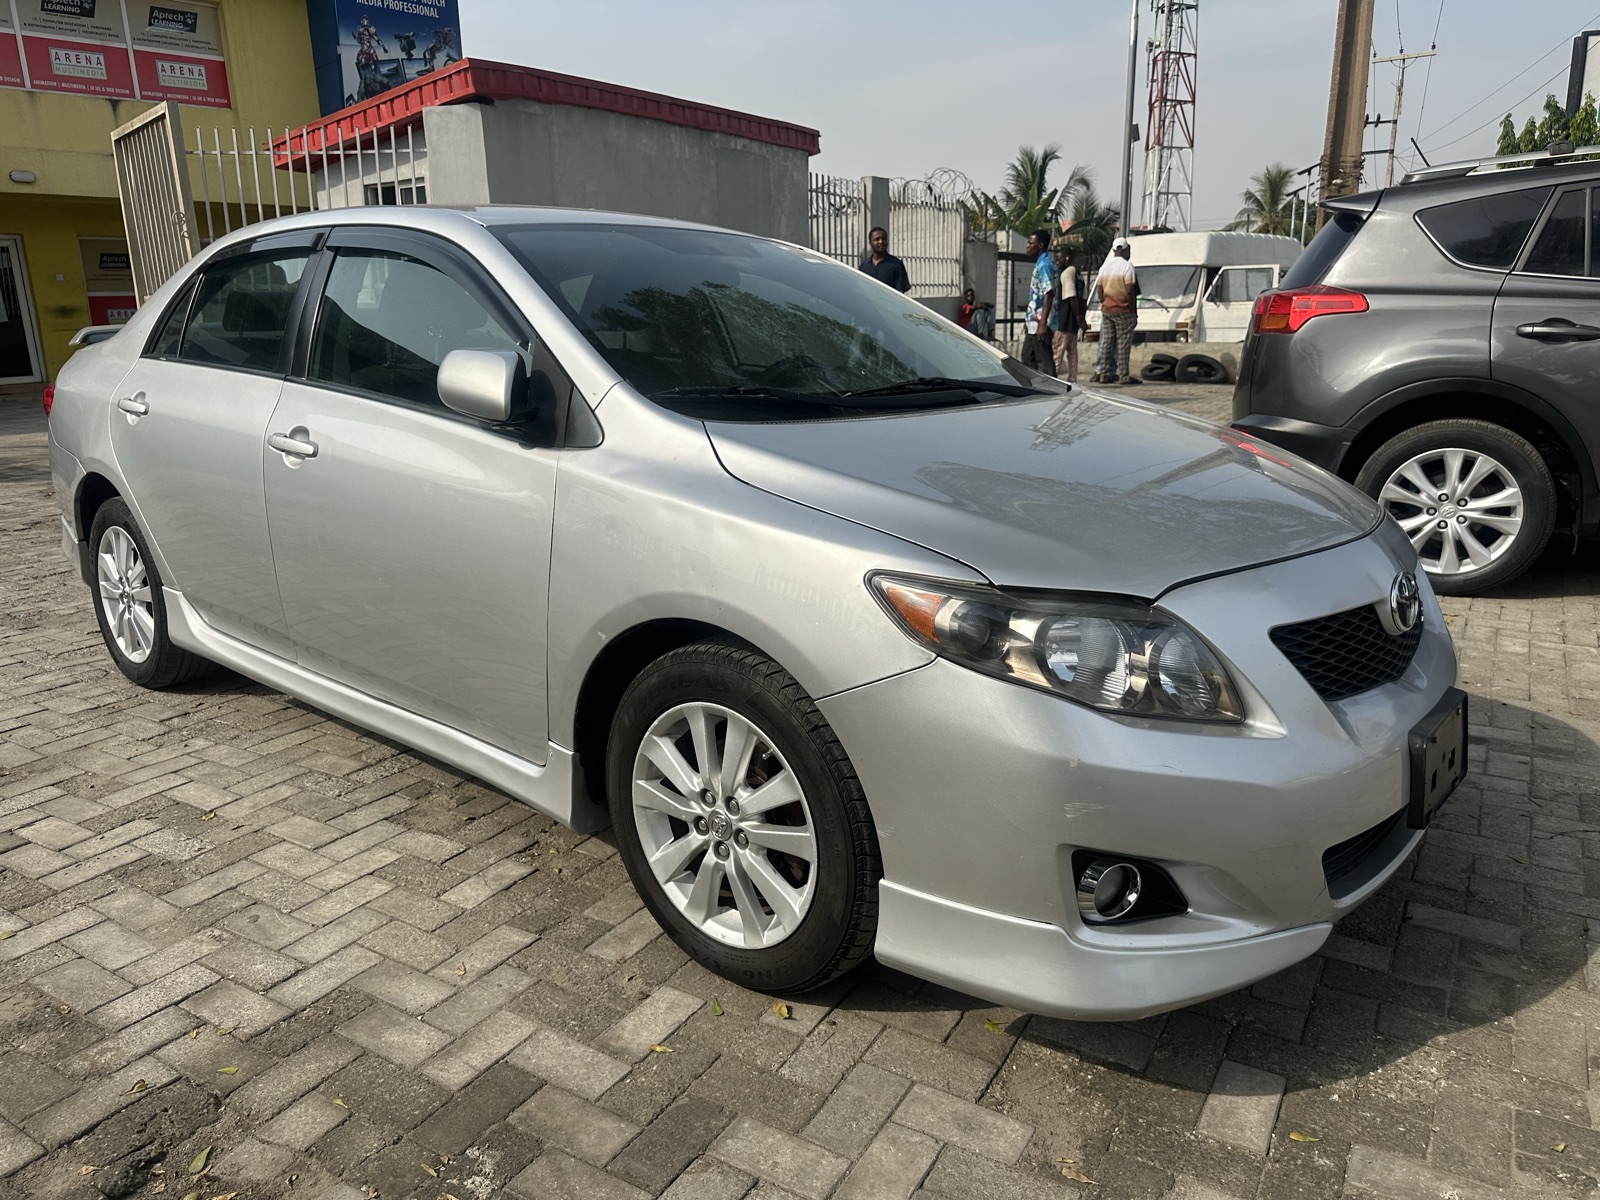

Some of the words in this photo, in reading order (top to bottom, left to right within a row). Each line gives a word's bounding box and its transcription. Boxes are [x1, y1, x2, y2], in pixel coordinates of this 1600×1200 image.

[44, 2, 81, 13] LEARNING
[384, 0, 440, 18] PROFESSIONAL
[152, 9, 184, 21] Aptech
[151, 18, 184, 29] LEARNING
[54, 51, 103, 67] ARENA
[55, 65, 105, 78] MULTIMEDIA
[160, 63, 204, 78] ARENA
[161, 77, 206, 88] MULTIMEDIA
[103, 255, 127, 263] Aptech
